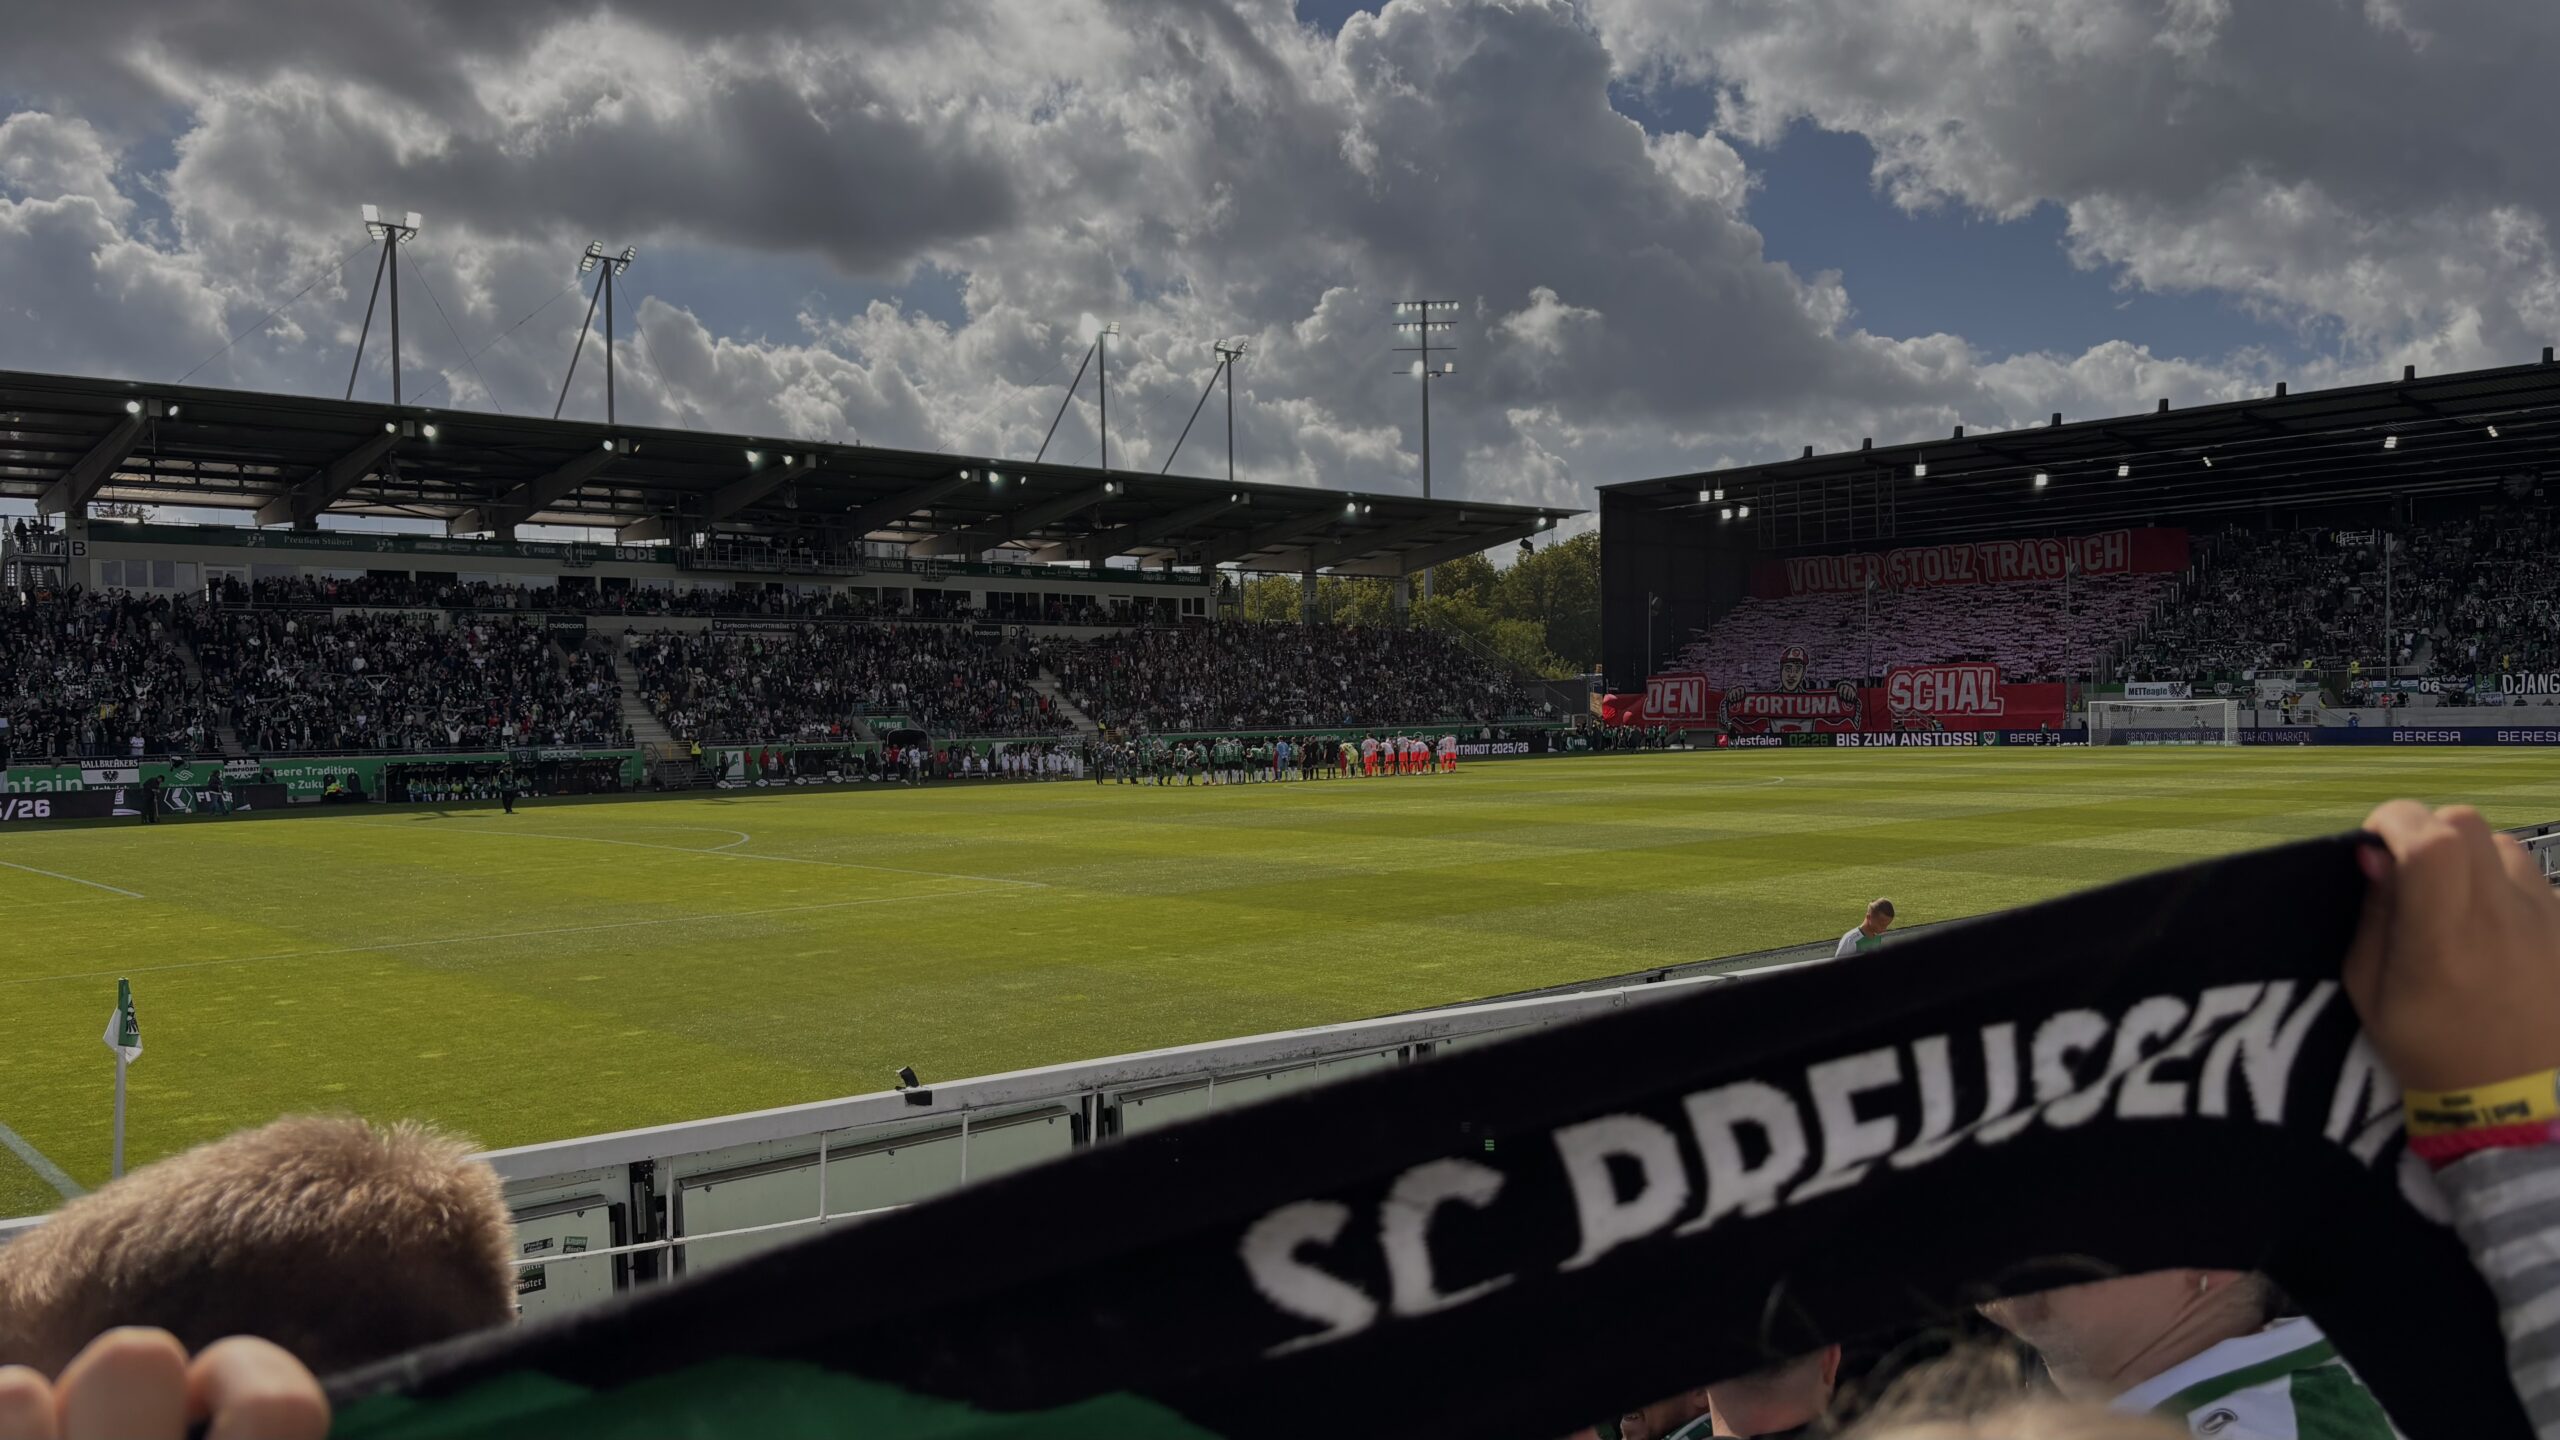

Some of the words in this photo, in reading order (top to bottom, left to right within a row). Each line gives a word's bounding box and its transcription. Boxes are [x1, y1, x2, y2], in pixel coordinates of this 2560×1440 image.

[72, 542, 85, 557] B
[616, 548, 656, 560] BODE
[1789, 556, 1887, 595] VOLLER
[1889, 544, 1977, 584] STOLZ
[1981, 539, 2064, 582] TRAG
[2069, 532, 2125, 575] ICH
[1210, 587, 1216, 597] E
[549, 622, 584, 631] guidecom
[1010, 626, 1018, 638] D
[1889, 671, 1999, 712] SCHAL
[2128, 687, 2168, 697] METTeagle
[2420, 681, 2440, 693] 06
[1645, 680, 1700, 715] DEN
[1743, 695, 1841, 715] FORTUNA
[1788, 735, 1829, 747] 02:26
[1836, 733, 1861, 746] BIS
[1864, 732, 1896, 746] ZUM
[1900, 732, 1978, 746] ANSTOSS!
[2393, 731, 2461, 742] BERESA
[1492, 741, 1529, 754] 2025/26
[81, 758, 138, 769] BALLBREAKERS
[305, 765, 358, 776] Tradition.
[1239, 1157, 1515, 1359] SC
